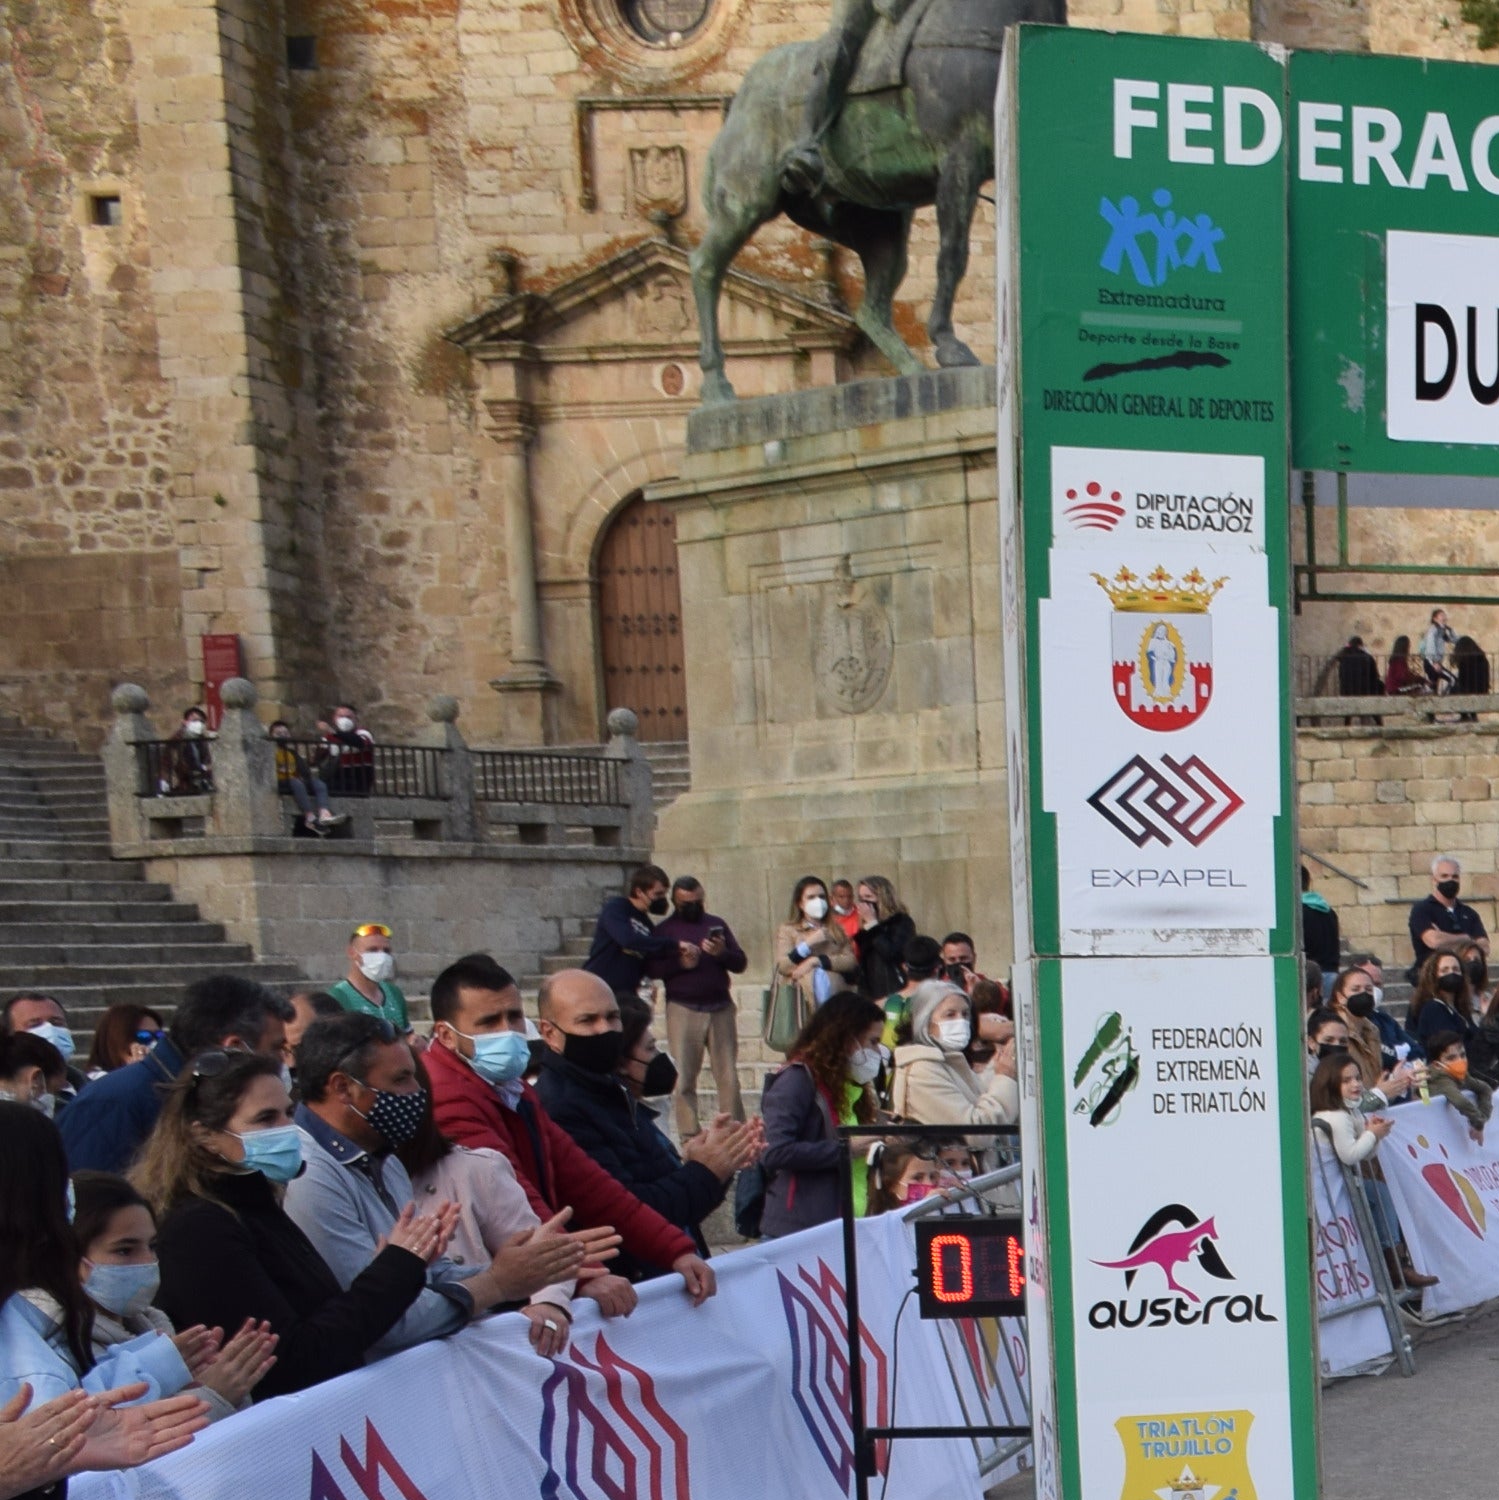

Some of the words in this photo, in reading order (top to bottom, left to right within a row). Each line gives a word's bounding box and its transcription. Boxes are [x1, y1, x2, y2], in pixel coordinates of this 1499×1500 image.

[1098, 288, 1226, 312] Extremadura
[1078, 328, 1137, 348] Deporte
[1142, 333, 1183, 347] desde
[1189, 336, 1202, 348] la
[1208, 338, 1240, 350] Base
[1043, 388, 1118, 415] DIRECCIÓN
[1123, 394, 1185, 418] GENERAL
[1189, 398, 1205, 419] DE
[1209, 400, 1275, 423] DEPORTES
[1136, 491, 1253, 516] DIPUTACIÓN
[1136, 514, 1155, 529] DE
[1160, 512, 1253, 533] BADAJOZ
[1091, 868, 1248, 889] EXPAPEL
[1151, 1022, 1263, 1051] FEDERACIÓN
[1156, 1055, 1261, 1083] EXTREMEÑA
[1153, 1092, 1177, 1116] DE
[1181, 1086, 1267, 1115] TRIATLÓN
[1087, 1293, 1279, 1330] austral
[1136, 1415, 1235, 1440] TRIATLÓN
[1140, 1437, 1233, 1459] TRUJILLO
